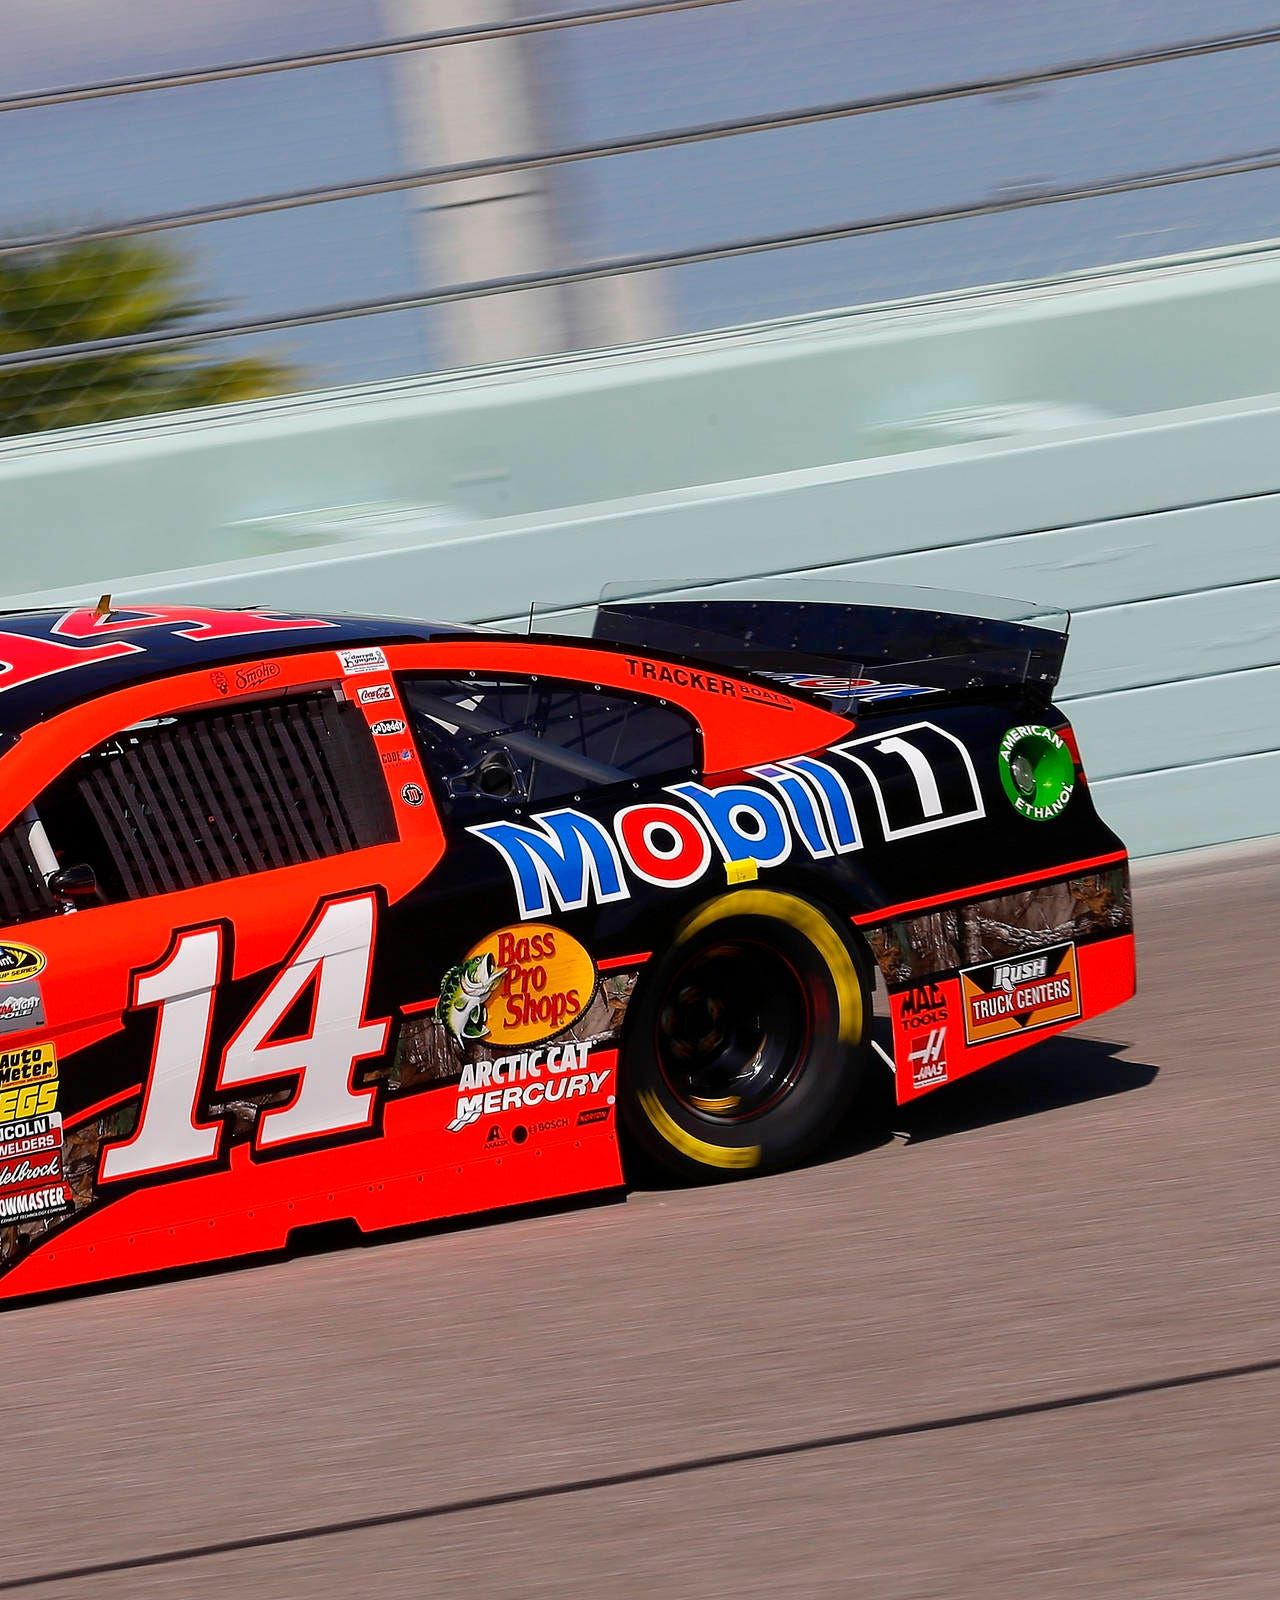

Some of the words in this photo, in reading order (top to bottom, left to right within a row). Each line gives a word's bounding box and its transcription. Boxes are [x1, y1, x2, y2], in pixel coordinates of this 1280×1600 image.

[236, 663, 280, 689] Smoke
[624, 657, 736, 698] TRACKER
[739, 685, 792, 704] BOATS
[372, 720, 403, 734] GoDaddy
[1000, 725, 1064, 762] AMERICAN
[1015, 784, 1074, 818] ETHANOL
[464, 755, 864, 920] Mobil
[497, 932, 556, 967] Bass
[11, 966, 38, 977] SERIES
[501, 964, 547, 997] Pro
[12, 997, 40, 1011] LIGHT
[503, 989, 581, 1028] Shops
[901, 983, 947, 1018] MAC
[973, 992, 1014, 1020] TRUCK
[1016, 979, 1070, 1008] CENTERS
[97, 892, 392, 1183] 14
[901, 1010, 949, 1031] TOOLS
[0, 1049, 42, 1068] Auto
[458, 1050, 542, 1092] ARCTIC
[546, 1042, 593, 1073] CAT
[452, 1070, 611, 1126] MERCURY
[538, 1119, 568, 1131] BOSCH
